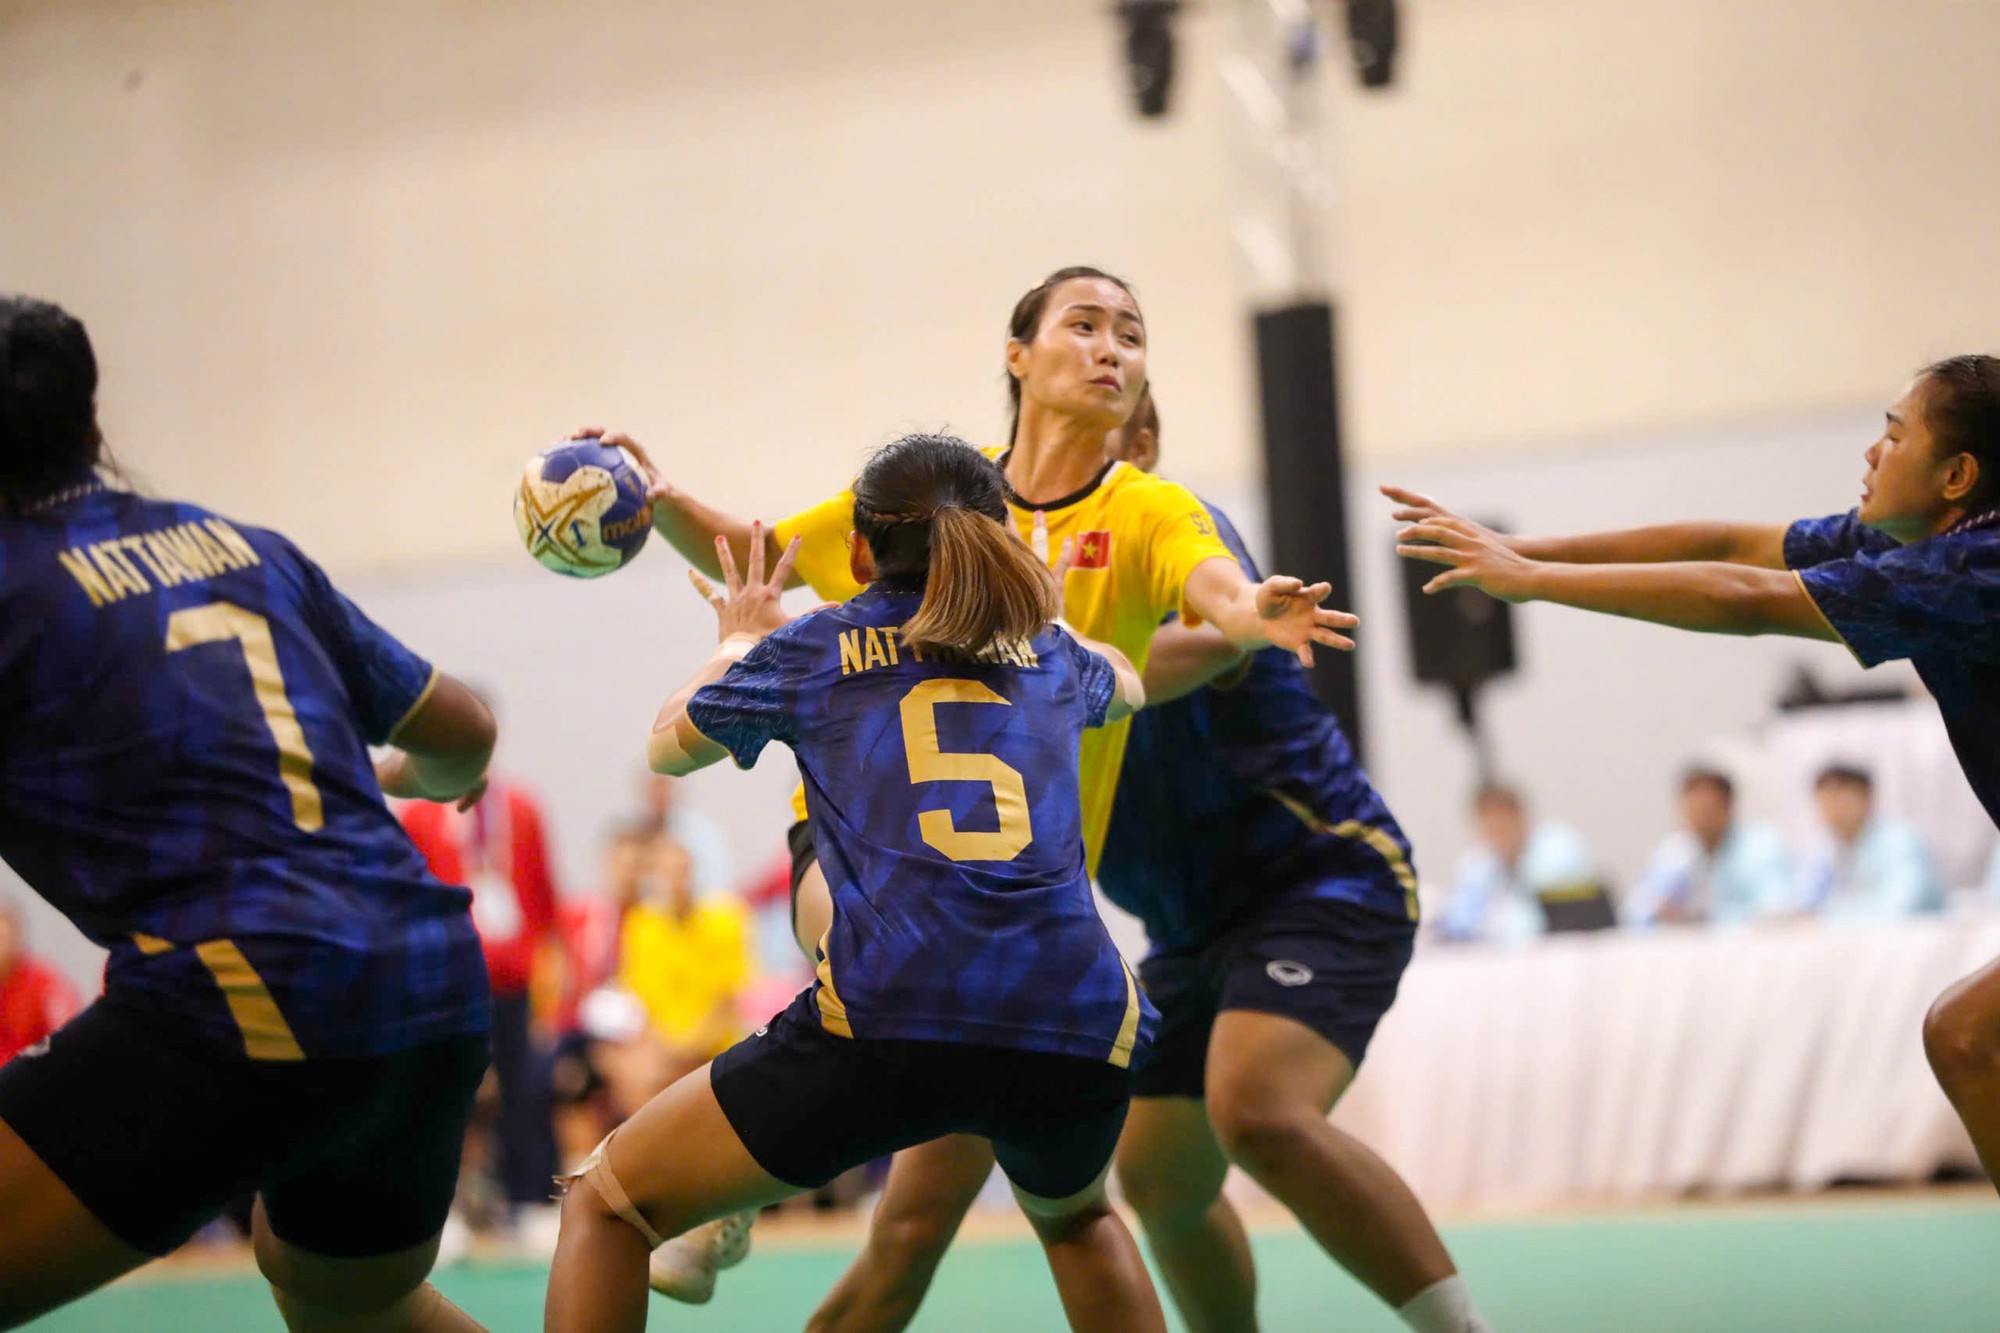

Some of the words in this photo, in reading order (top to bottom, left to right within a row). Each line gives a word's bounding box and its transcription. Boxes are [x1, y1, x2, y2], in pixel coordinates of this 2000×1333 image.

[58, 518, 261, 608] NATTAWAN
[165, 601, 324, 833] 7
[899, 678, 1033, 861] 5
